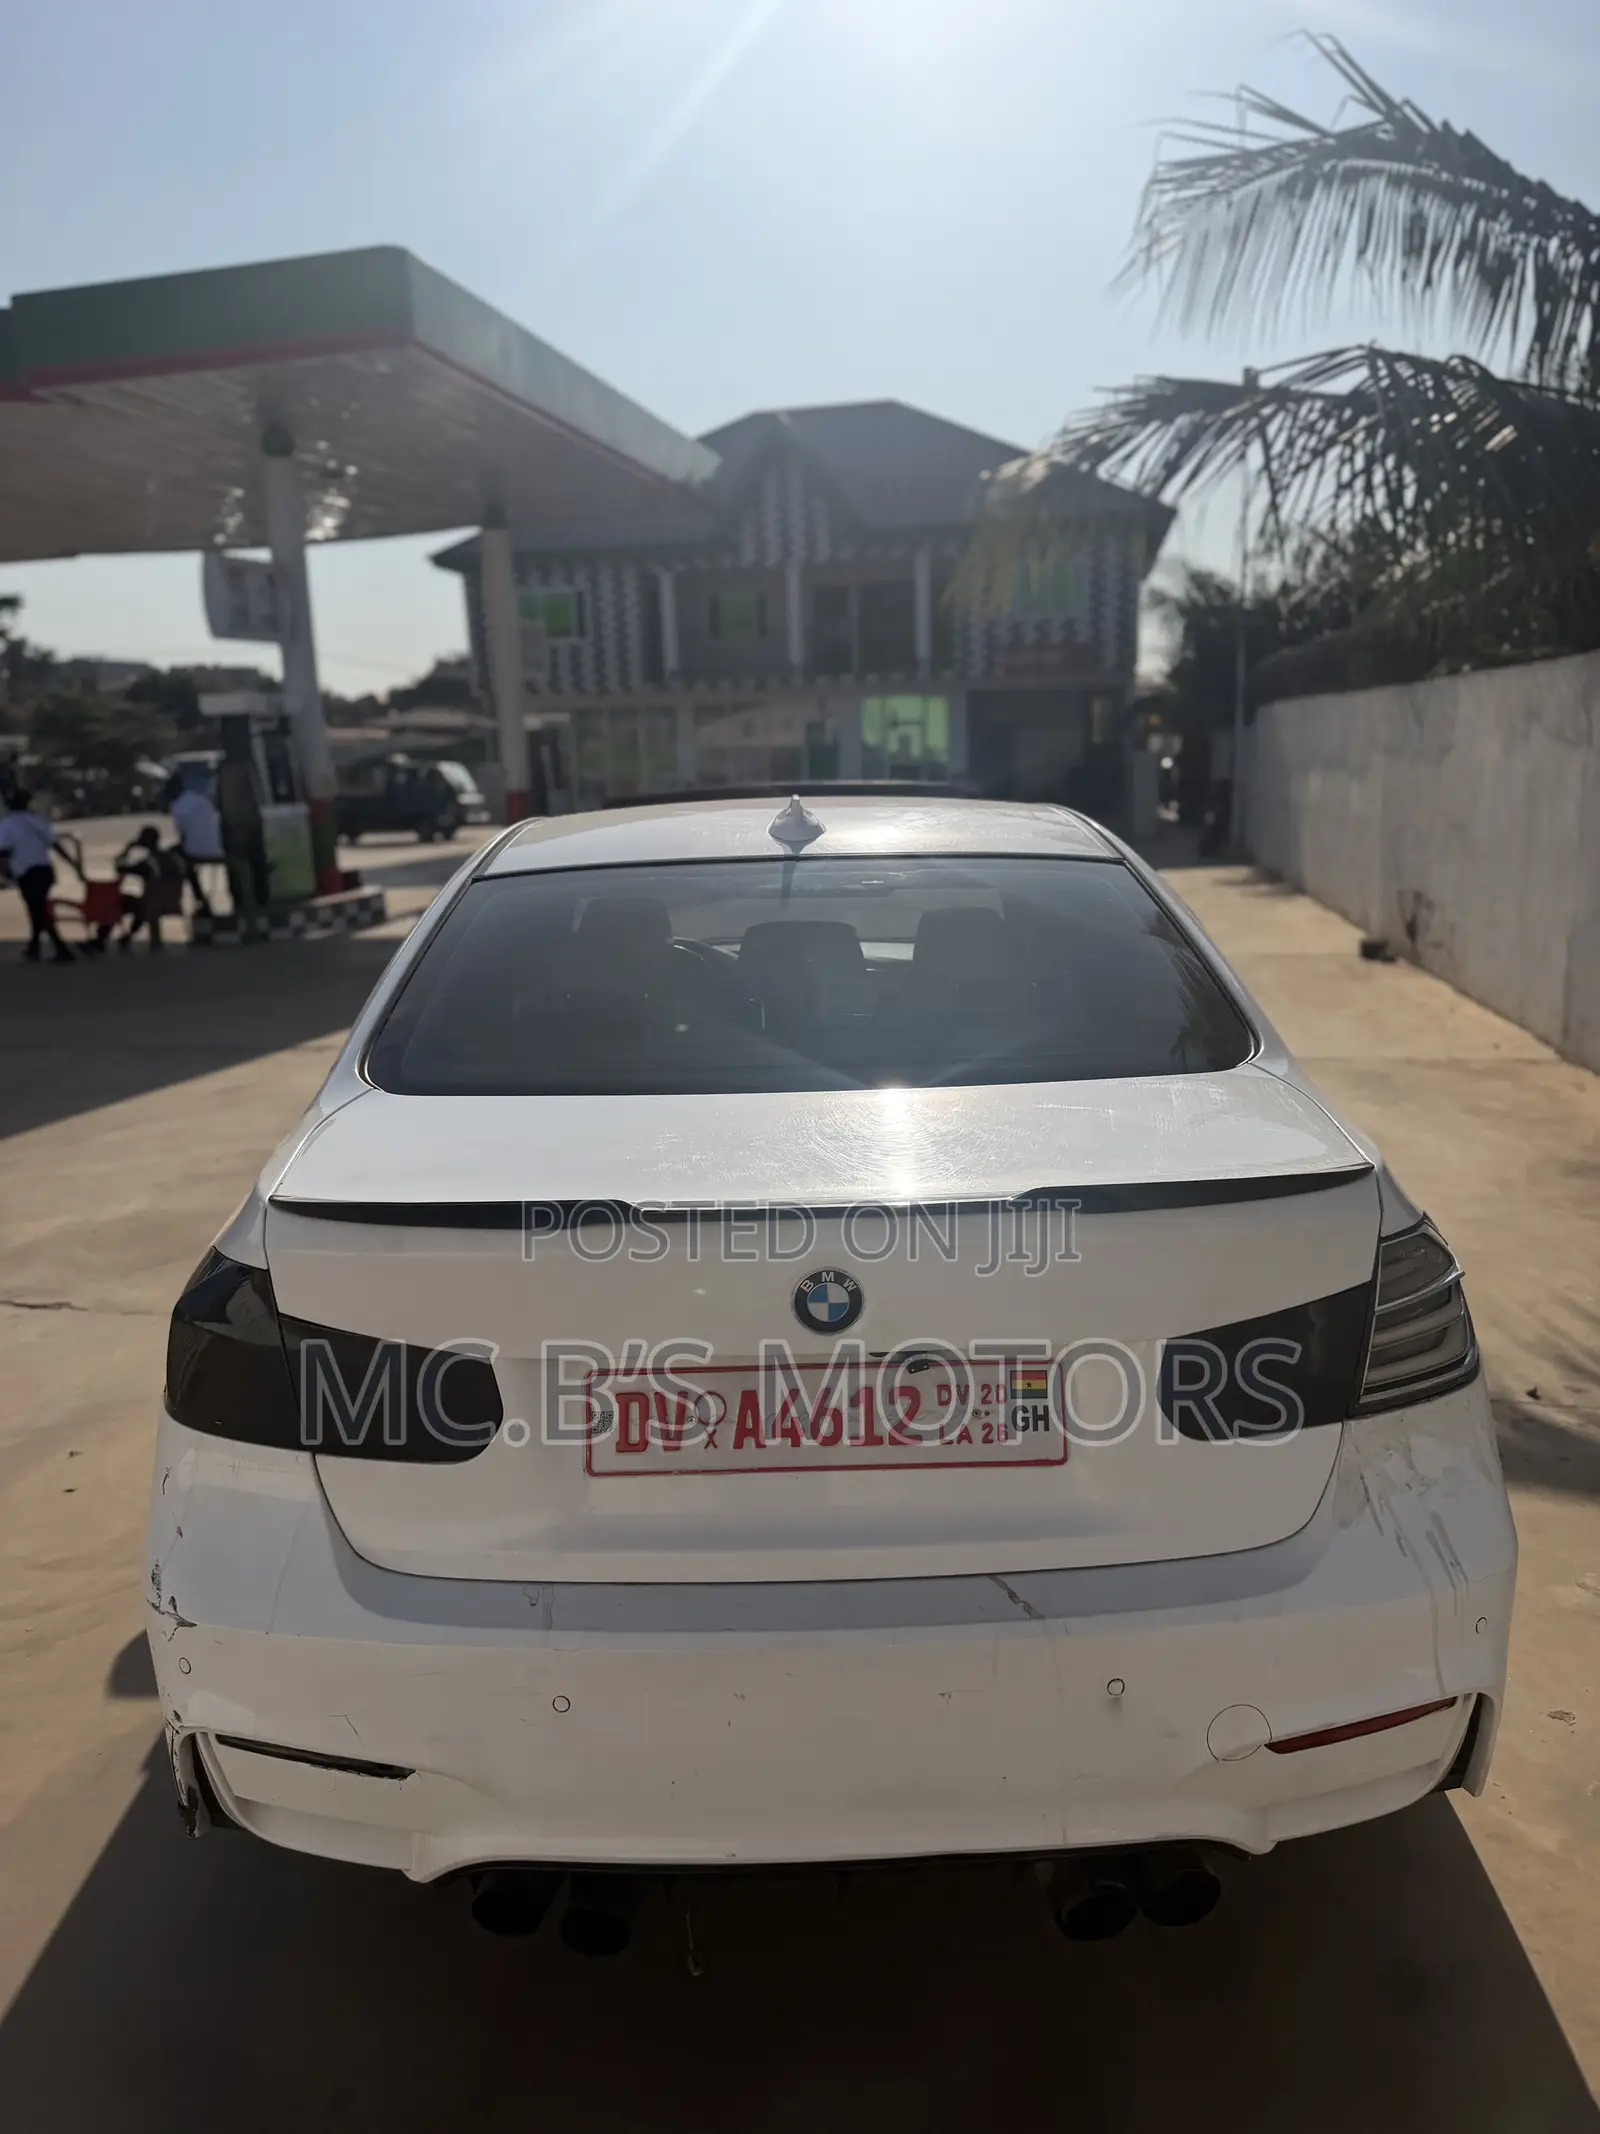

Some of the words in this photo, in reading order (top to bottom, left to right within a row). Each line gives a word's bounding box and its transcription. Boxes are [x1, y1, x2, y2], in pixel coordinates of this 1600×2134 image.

[799, 1271, 858, 1293] BMW
[936, 1383, 970, 1406] DV
[615, 1391, 689, 1453] DV
[733, 1385, 922, 1449] A4612
[1011, 1405, 1050, 1432] GH
